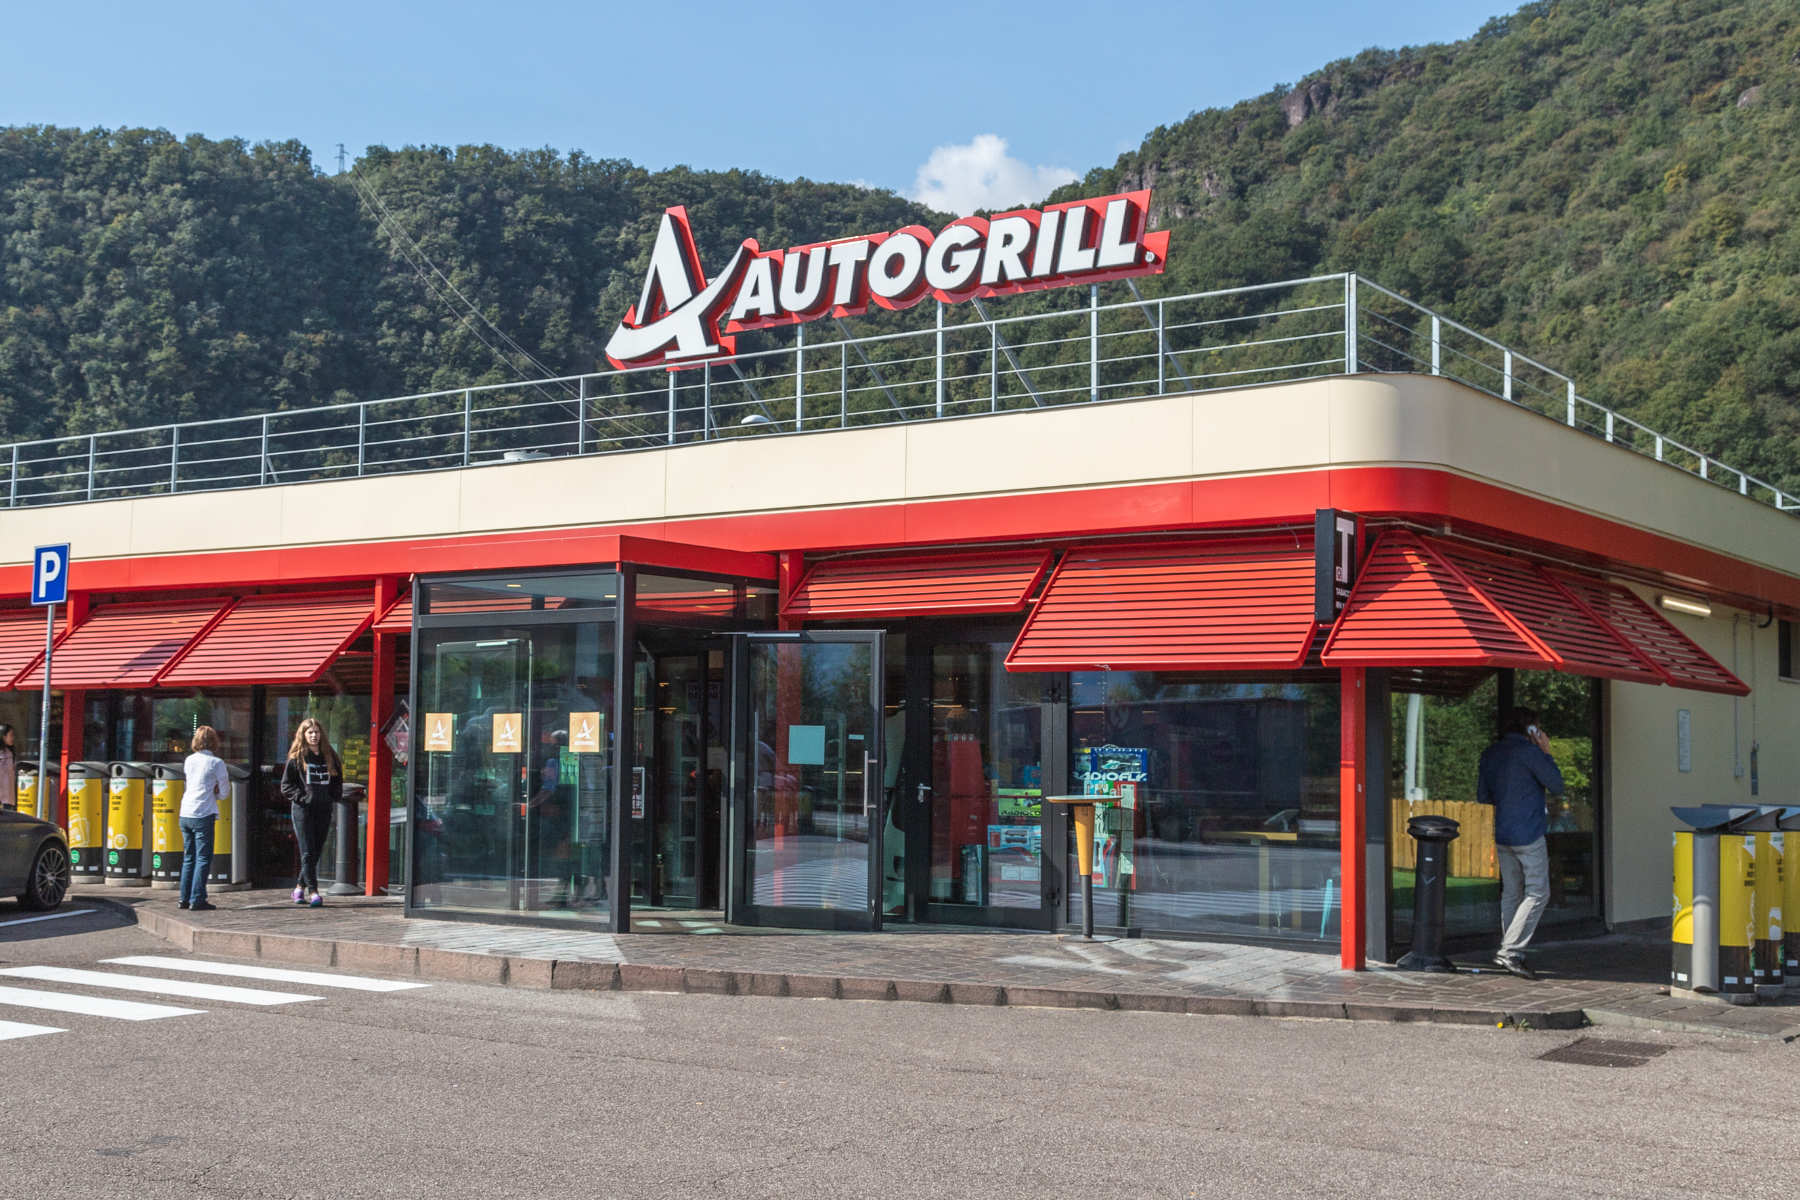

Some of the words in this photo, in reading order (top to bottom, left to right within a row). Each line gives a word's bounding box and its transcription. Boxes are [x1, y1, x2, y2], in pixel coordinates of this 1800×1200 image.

[728, 198, 1138, 321] AUTOGRILL
[39, 551, 61, 598] P
[1336, 517, 1354, 583] T
